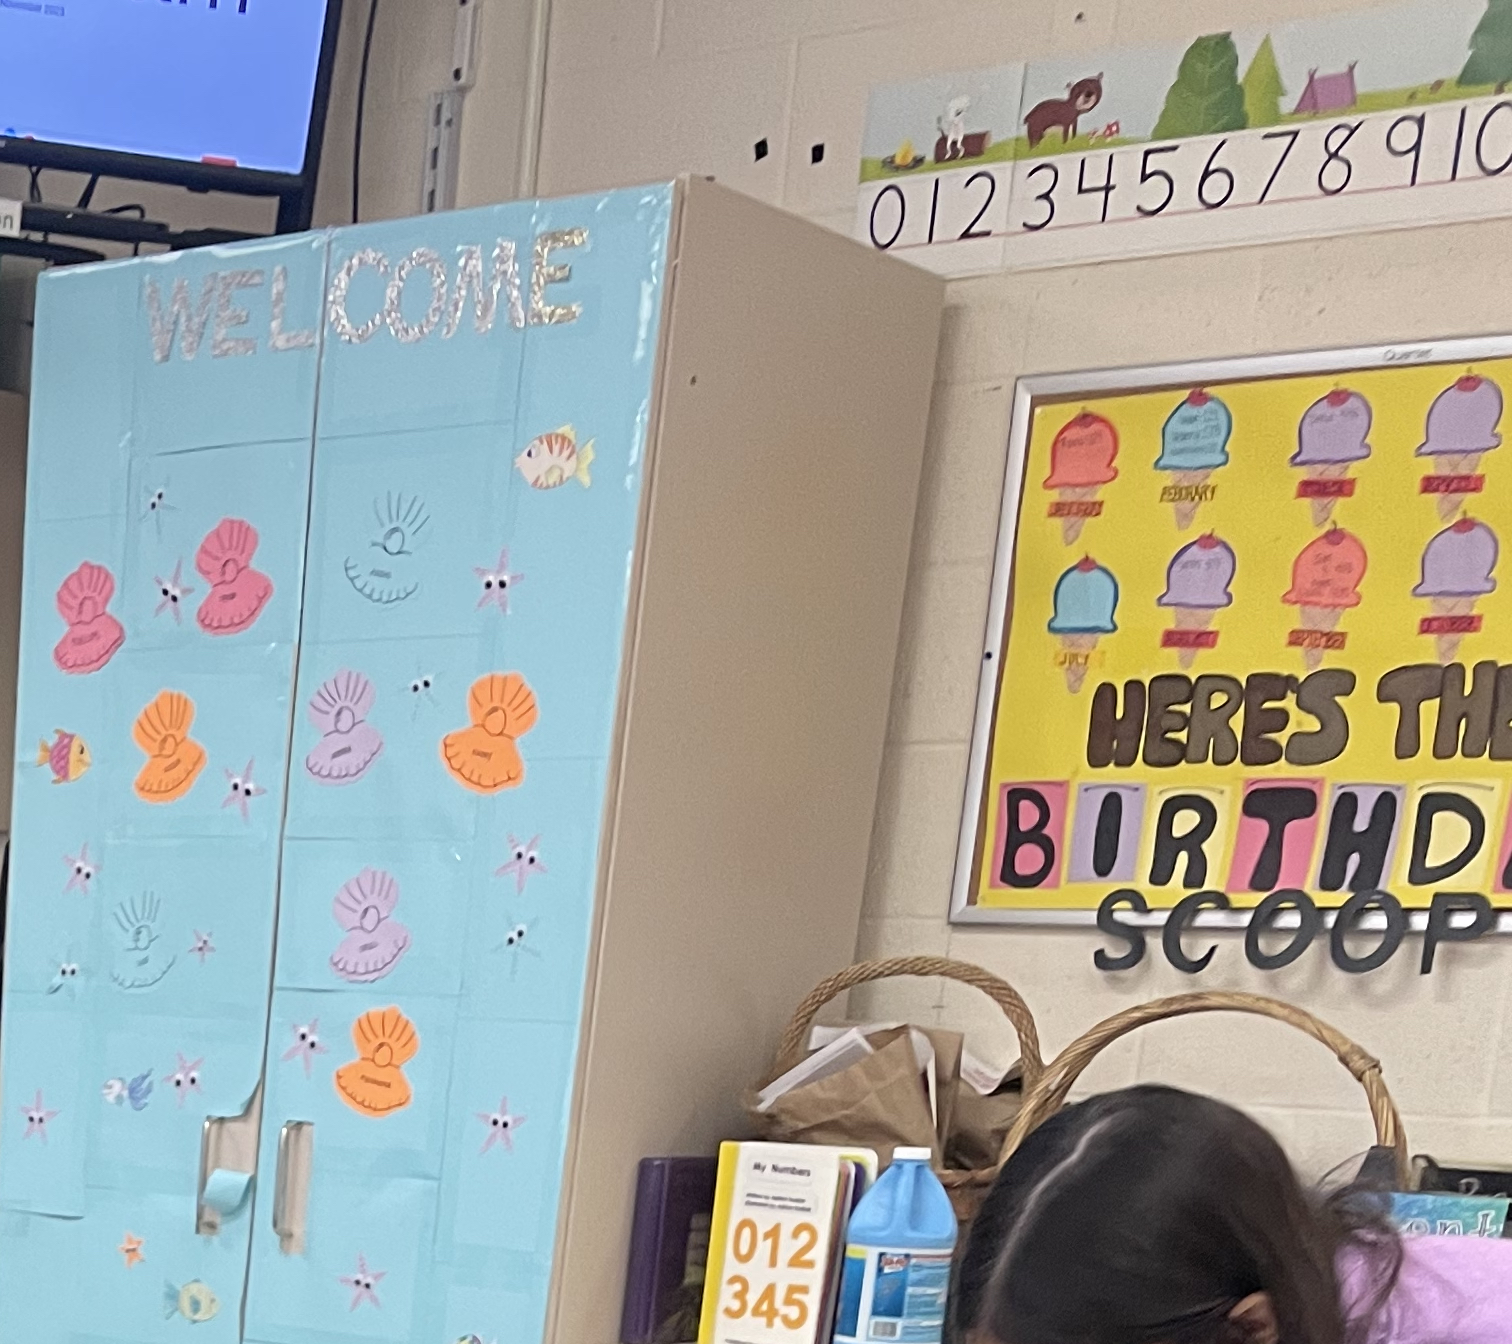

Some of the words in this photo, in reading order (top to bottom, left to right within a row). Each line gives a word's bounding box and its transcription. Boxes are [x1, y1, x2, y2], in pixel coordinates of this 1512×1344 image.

[145, 228, 589, 363] WELCOME
[1086, 667, 1357, 768] HERE'S
[998, 786, 1512, 893] BIRTHD
[1092, 888, 1493, 975] SCOOP
[752, 1161, 767, 1174] My
[771, 1163, 811, 1177] Numbers
